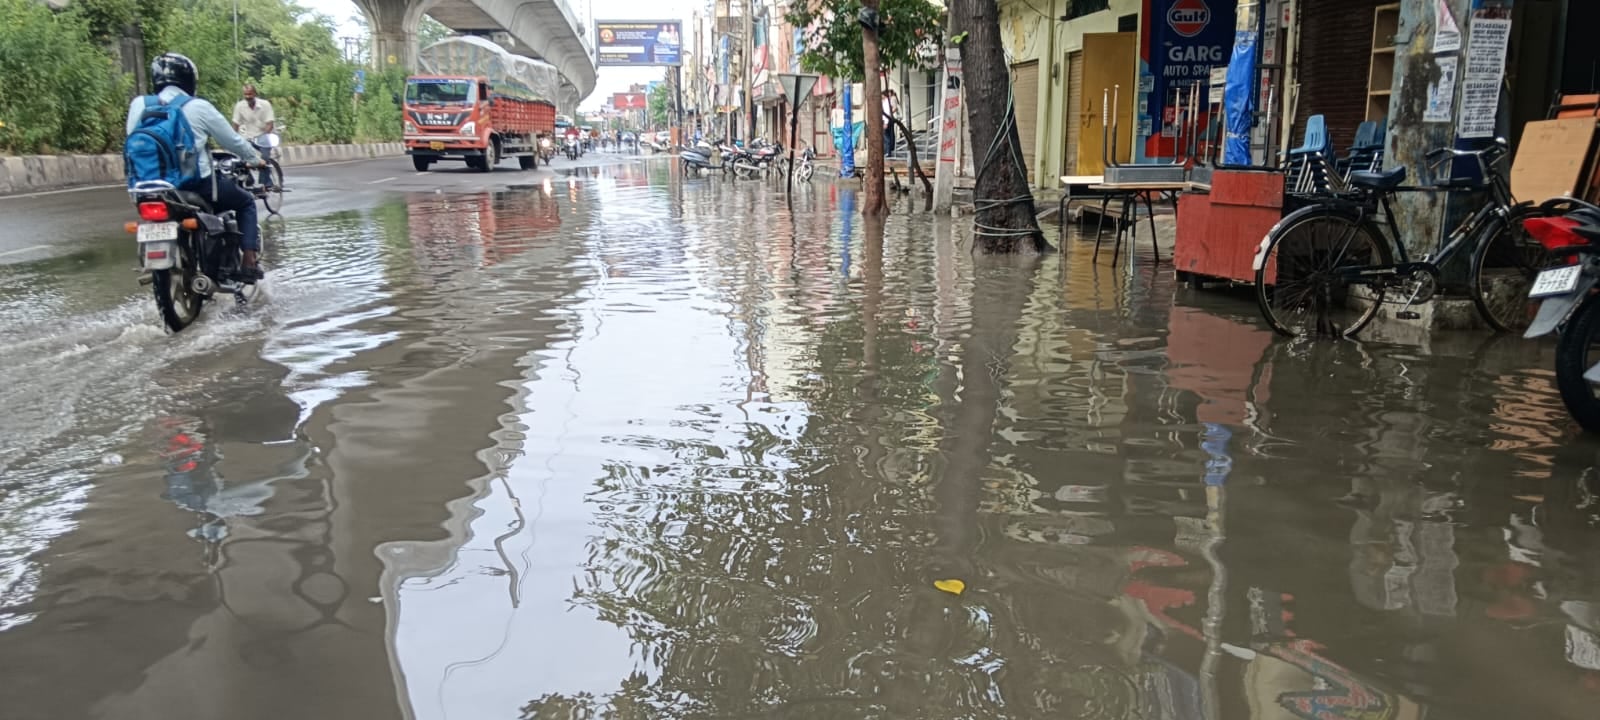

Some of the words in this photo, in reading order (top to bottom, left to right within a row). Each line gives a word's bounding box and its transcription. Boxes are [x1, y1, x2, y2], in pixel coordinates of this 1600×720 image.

[1171, 10, 1206, 23] Gulf
[1168, 45, 1223, 62] GARG
[1163, 65, 1189, 76] AUTO
[1192, 64, 1214, 76] SPA
